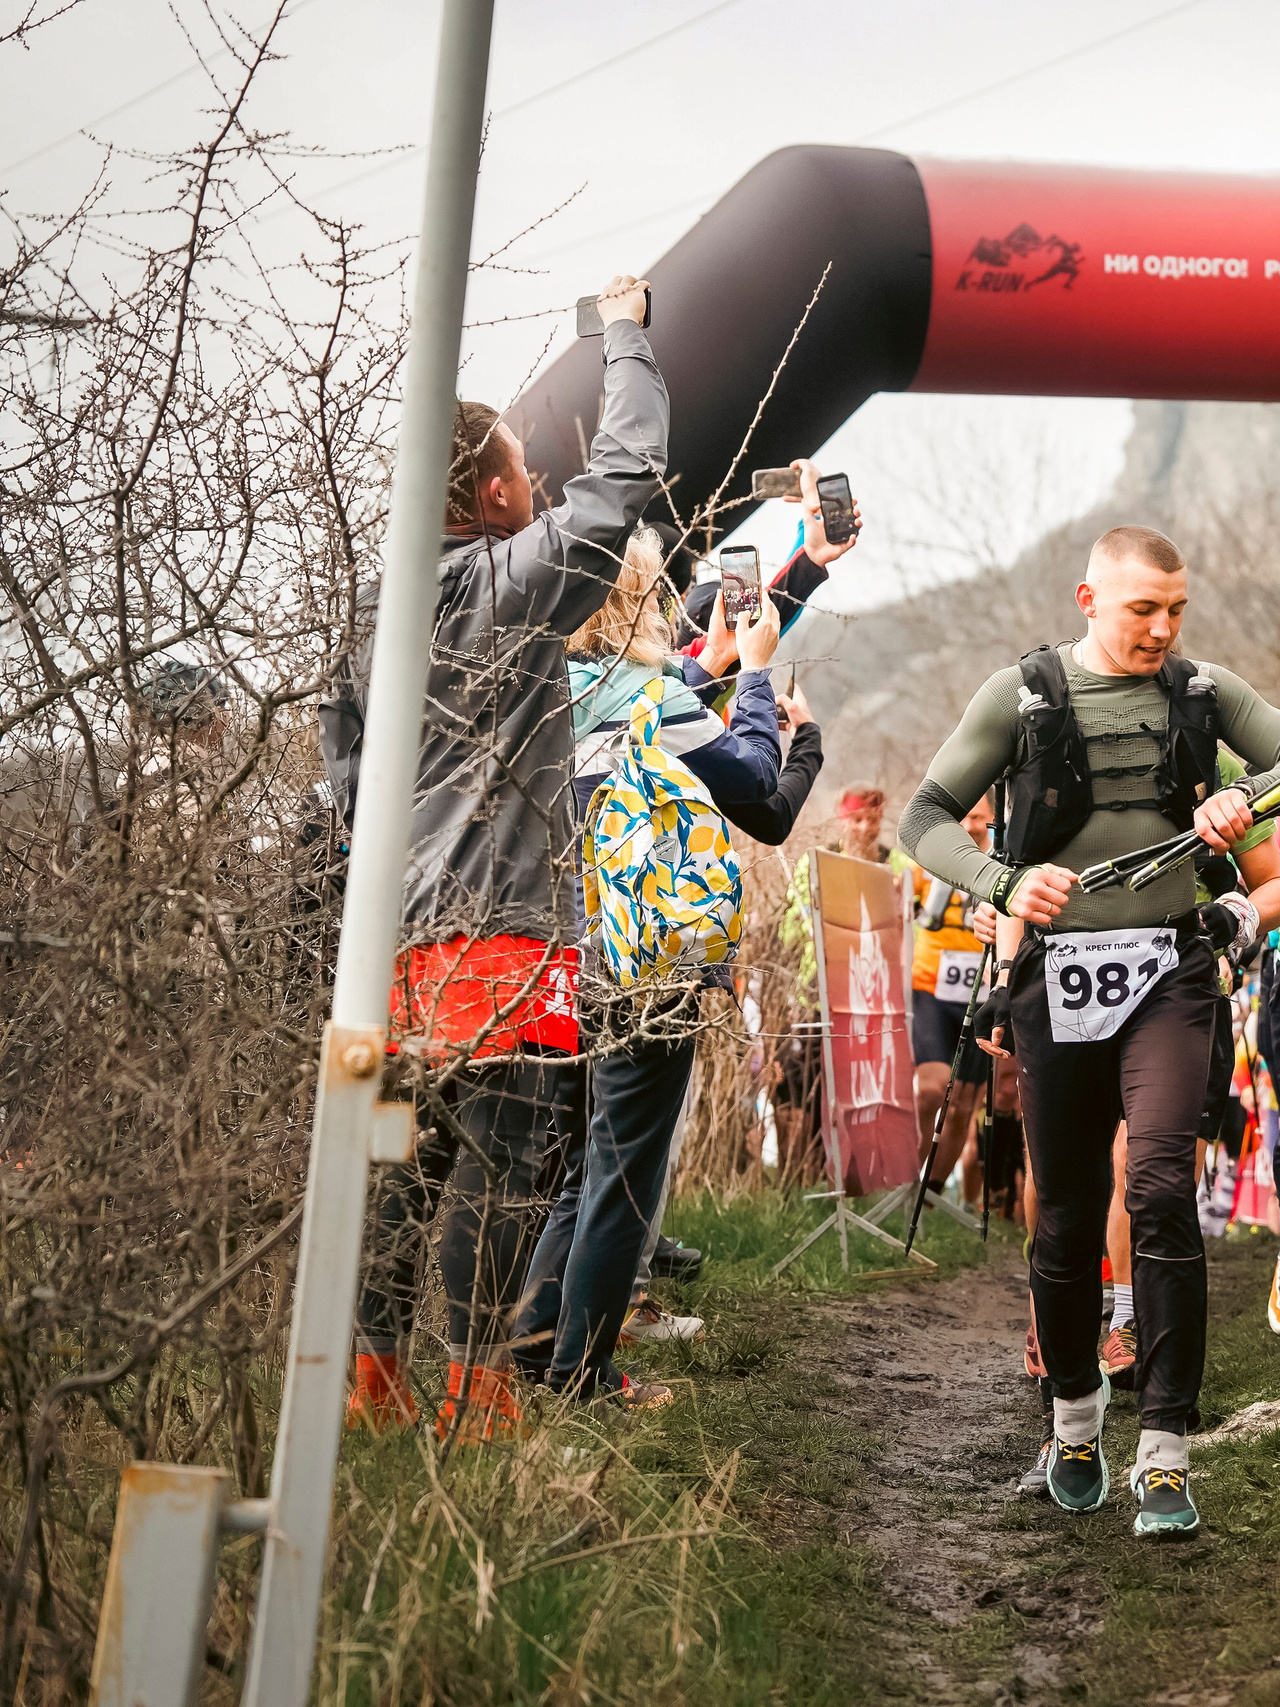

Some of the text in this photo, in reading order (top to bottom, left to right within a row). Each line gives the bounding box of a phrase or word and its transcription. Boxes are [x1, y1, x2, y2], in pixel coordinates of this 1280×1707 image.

[1104, 253, 1139, 274] НИ
[1143, 255, 1248, 279] ОДНОГО!
[1085, 941, 1140, 952] КРЕСТ ПЛЮС
